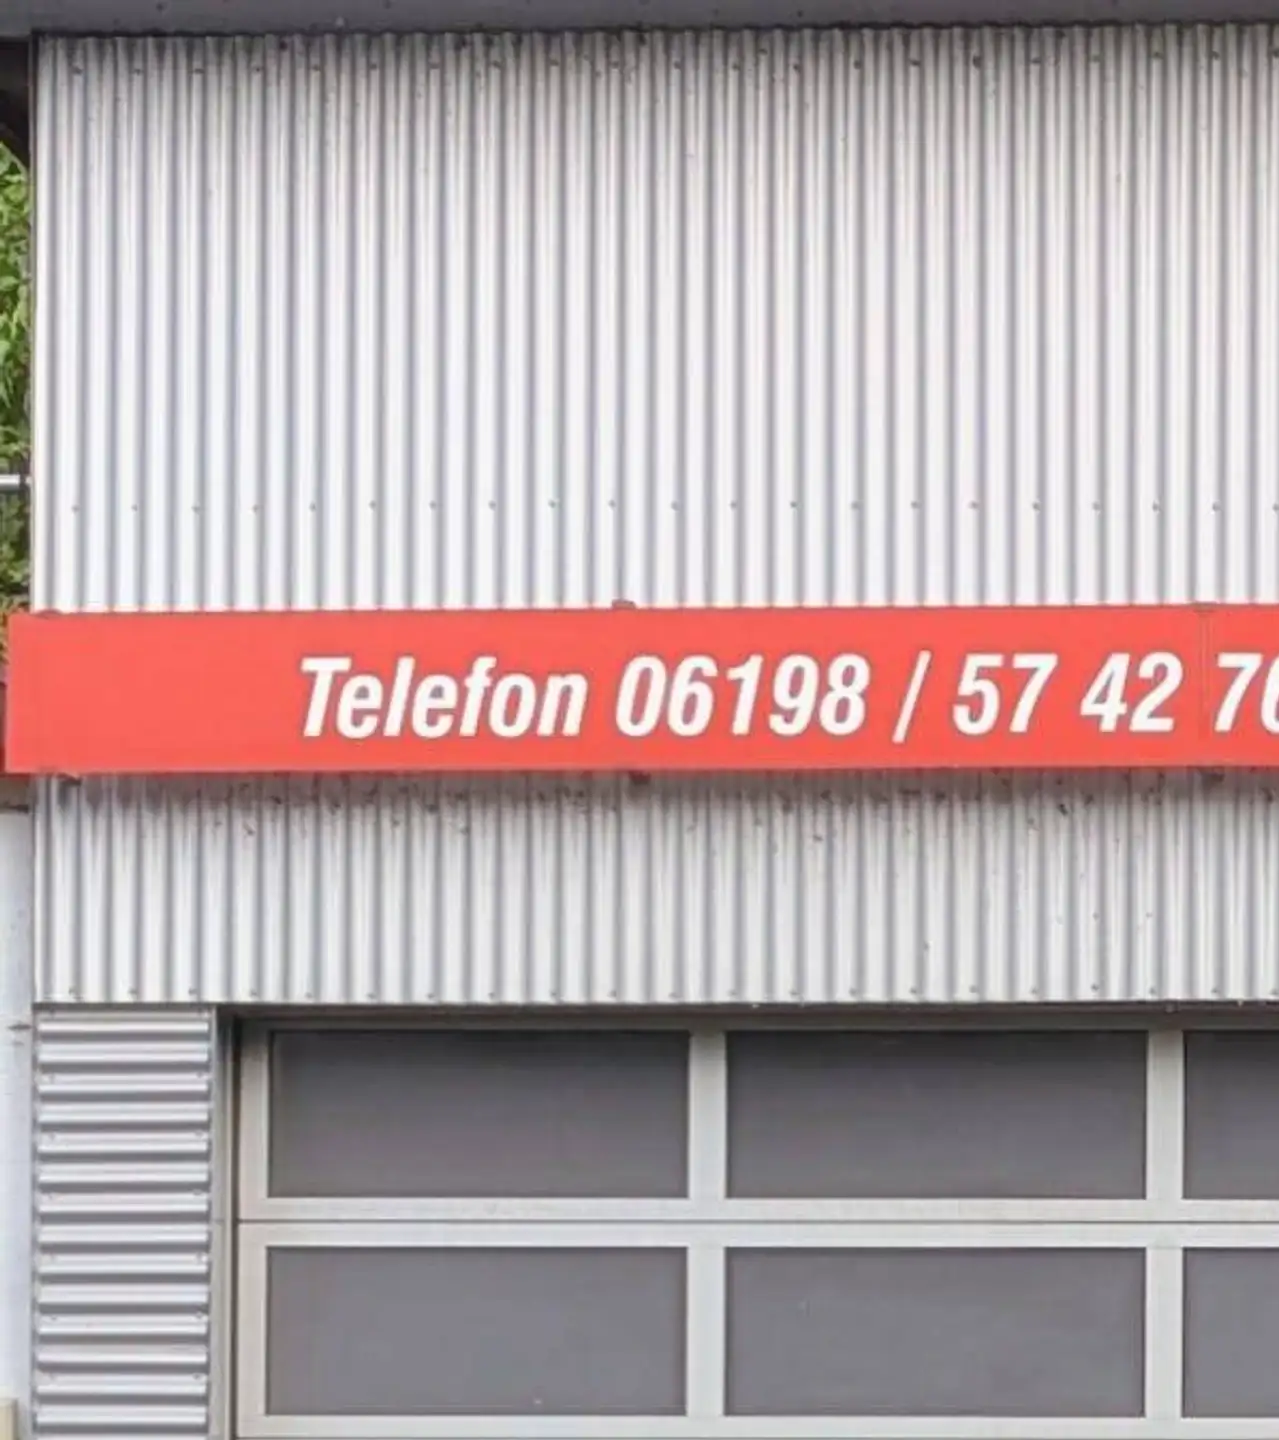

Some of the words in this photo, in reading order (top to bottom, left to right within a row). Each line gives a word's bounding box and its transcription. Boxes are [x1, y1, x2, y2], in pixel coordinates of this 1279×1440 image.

[300, 656, 588, 739] Telefon
[614, 654, 871, 737] 06198
[892, 651, 932, 743] /
[952, 653, 1059, 736] 57
[1079, 651, 1184, 733] 42
